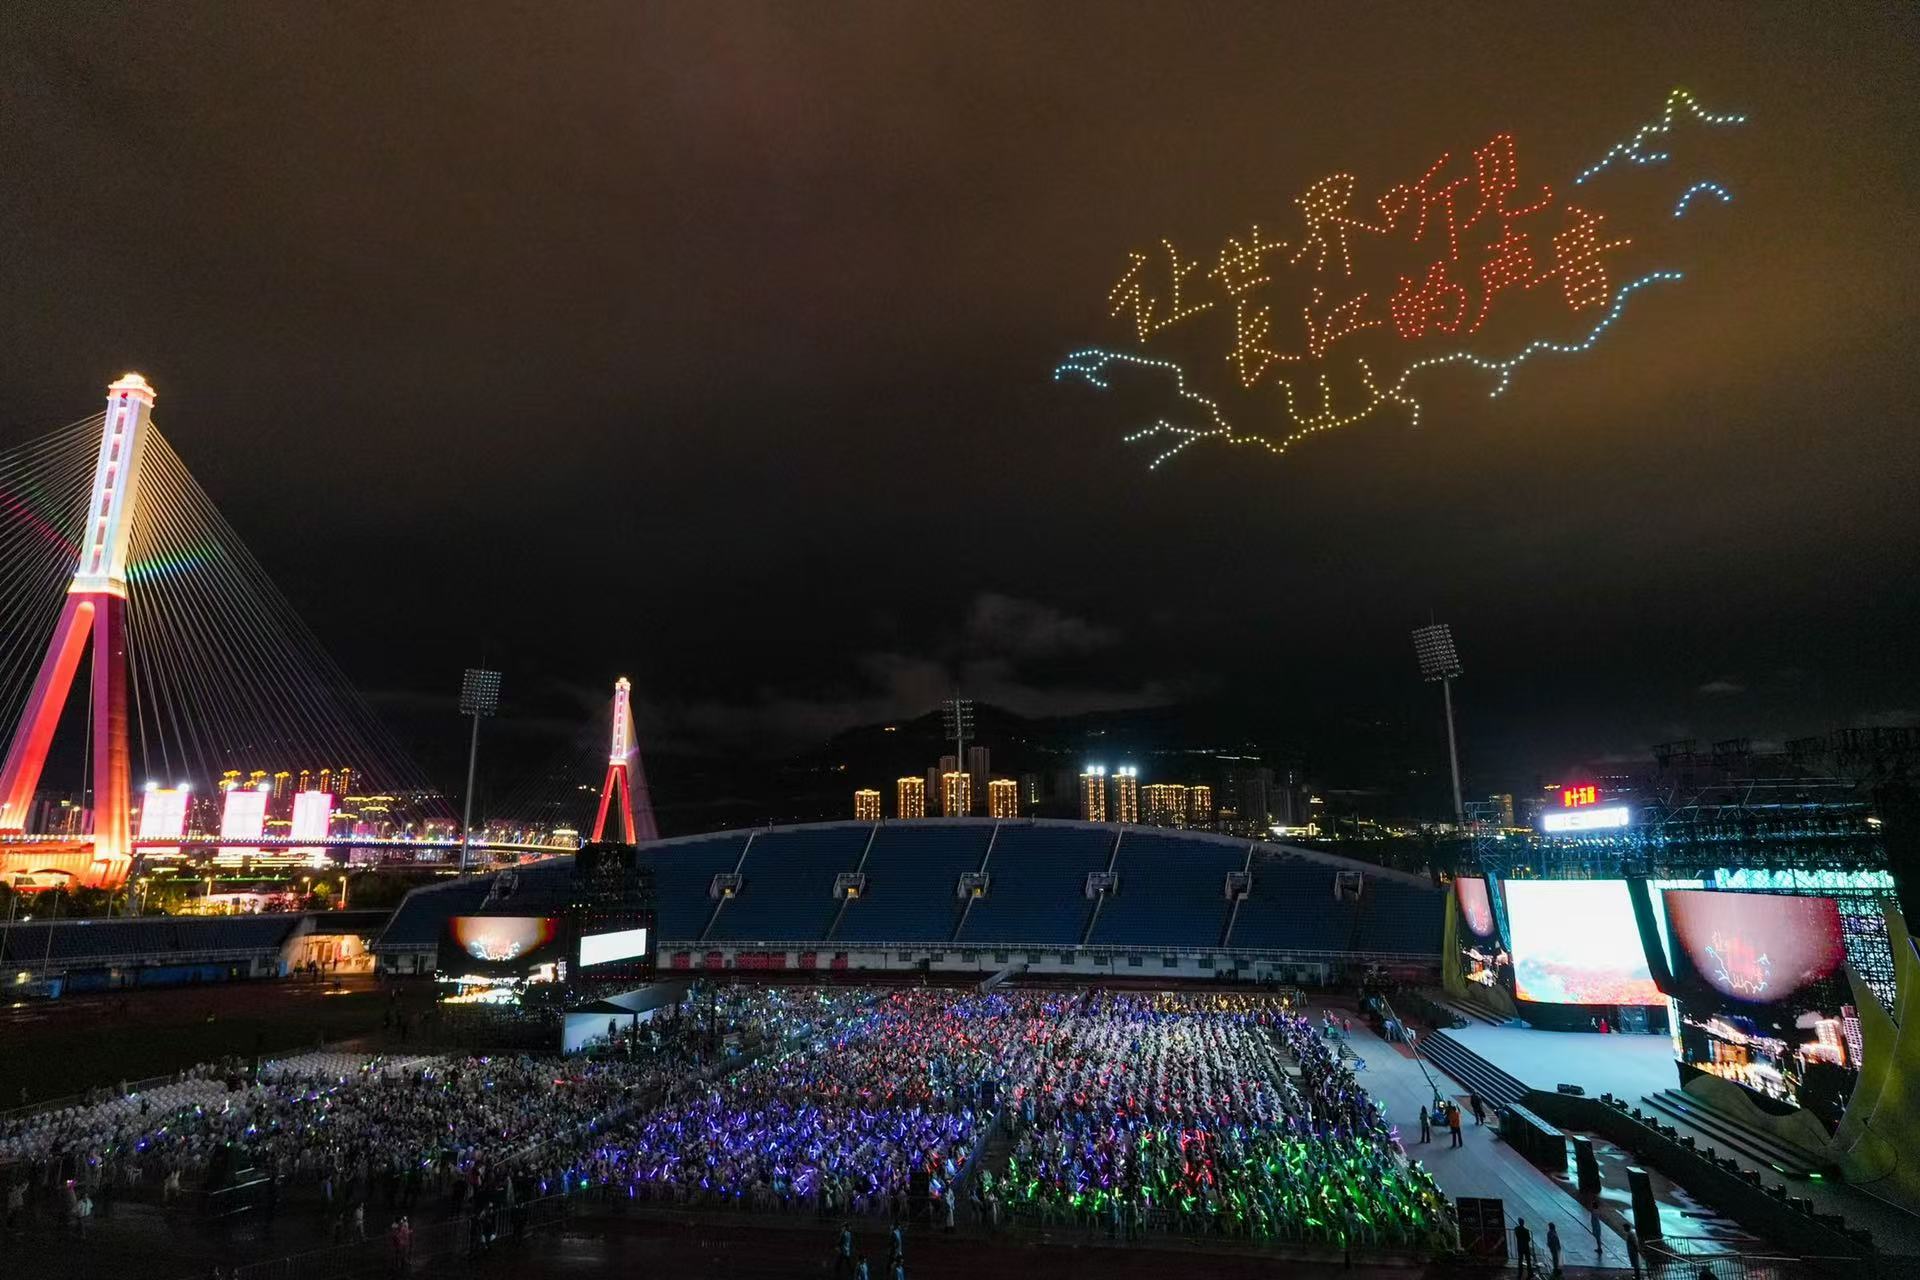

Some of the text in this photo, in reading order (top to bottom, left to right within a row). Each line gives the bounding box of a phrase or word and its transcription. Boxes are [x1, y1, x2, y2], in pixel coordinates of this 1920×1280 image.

[1108, 134, 1553, 343] 让世界听见
[1225, 206, 1631, 387] 长江的声音
